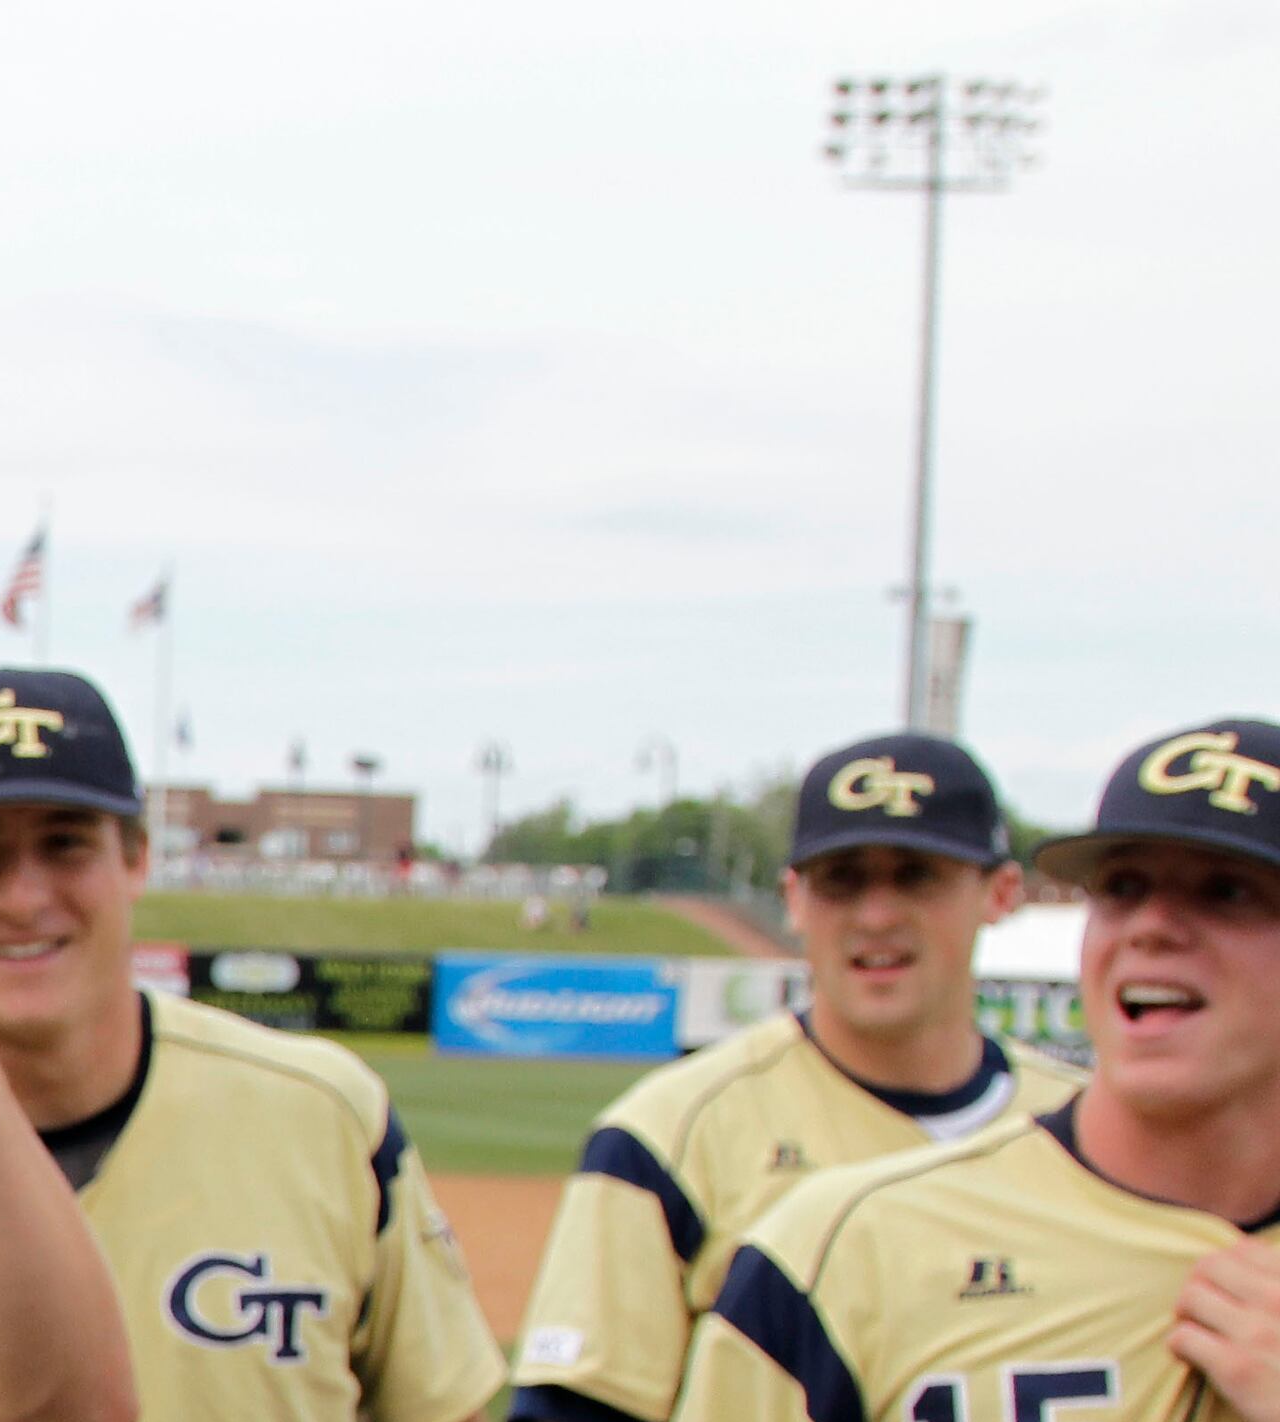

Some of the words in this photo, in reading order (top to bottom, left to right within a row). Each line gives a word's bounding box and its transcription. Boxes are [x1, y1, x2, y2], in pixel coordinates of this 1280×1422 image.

[827, 756, 936, 816] GT
[1137, 731, 1280, 815] GT
[162, 1248, 330, 1367] GT
